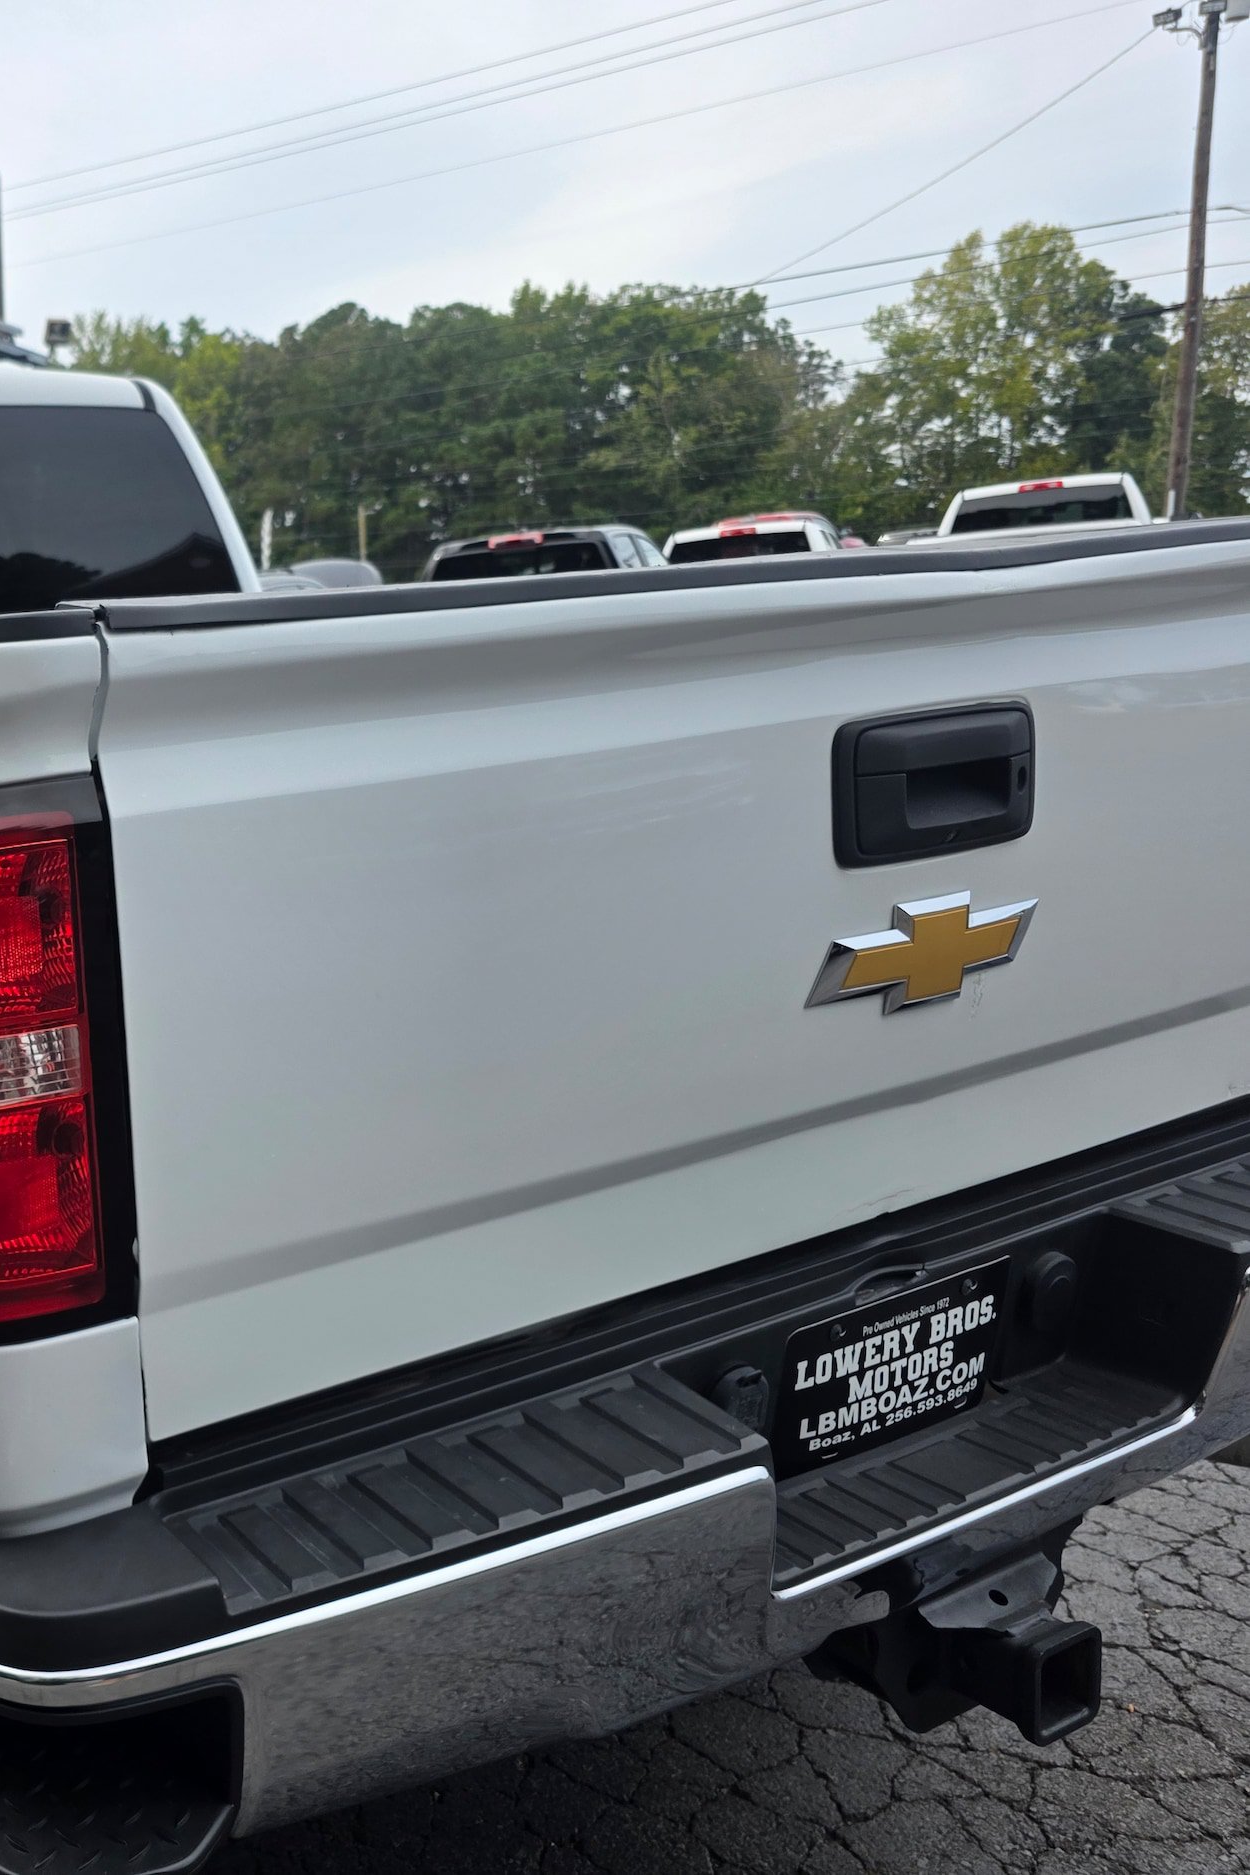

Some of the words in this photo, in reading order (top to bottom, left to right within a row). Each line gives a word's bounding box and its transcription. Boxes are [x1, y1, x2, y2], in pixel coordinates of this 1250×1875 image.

[794, 1321, 921, 1391] LOWERY
[929, 1295, 996, 1345] BROS.
[874, 1316, 894, 1333] Owned
[895, 1309, 919, 1325] Vehicles
[919, 1304, 936, 1317] Since
[936, 1296, 950, 1310] 1972
[799, 1352, 986, 1440] LBMBOAZ.COM
[848, 1340, 955, 1403] MOTORS
[809, 1431, 855, 1452] Boaz,
[860, 1420, 881, 1436] AL
[885, 1377, 978, 1427] 256.593.8649
